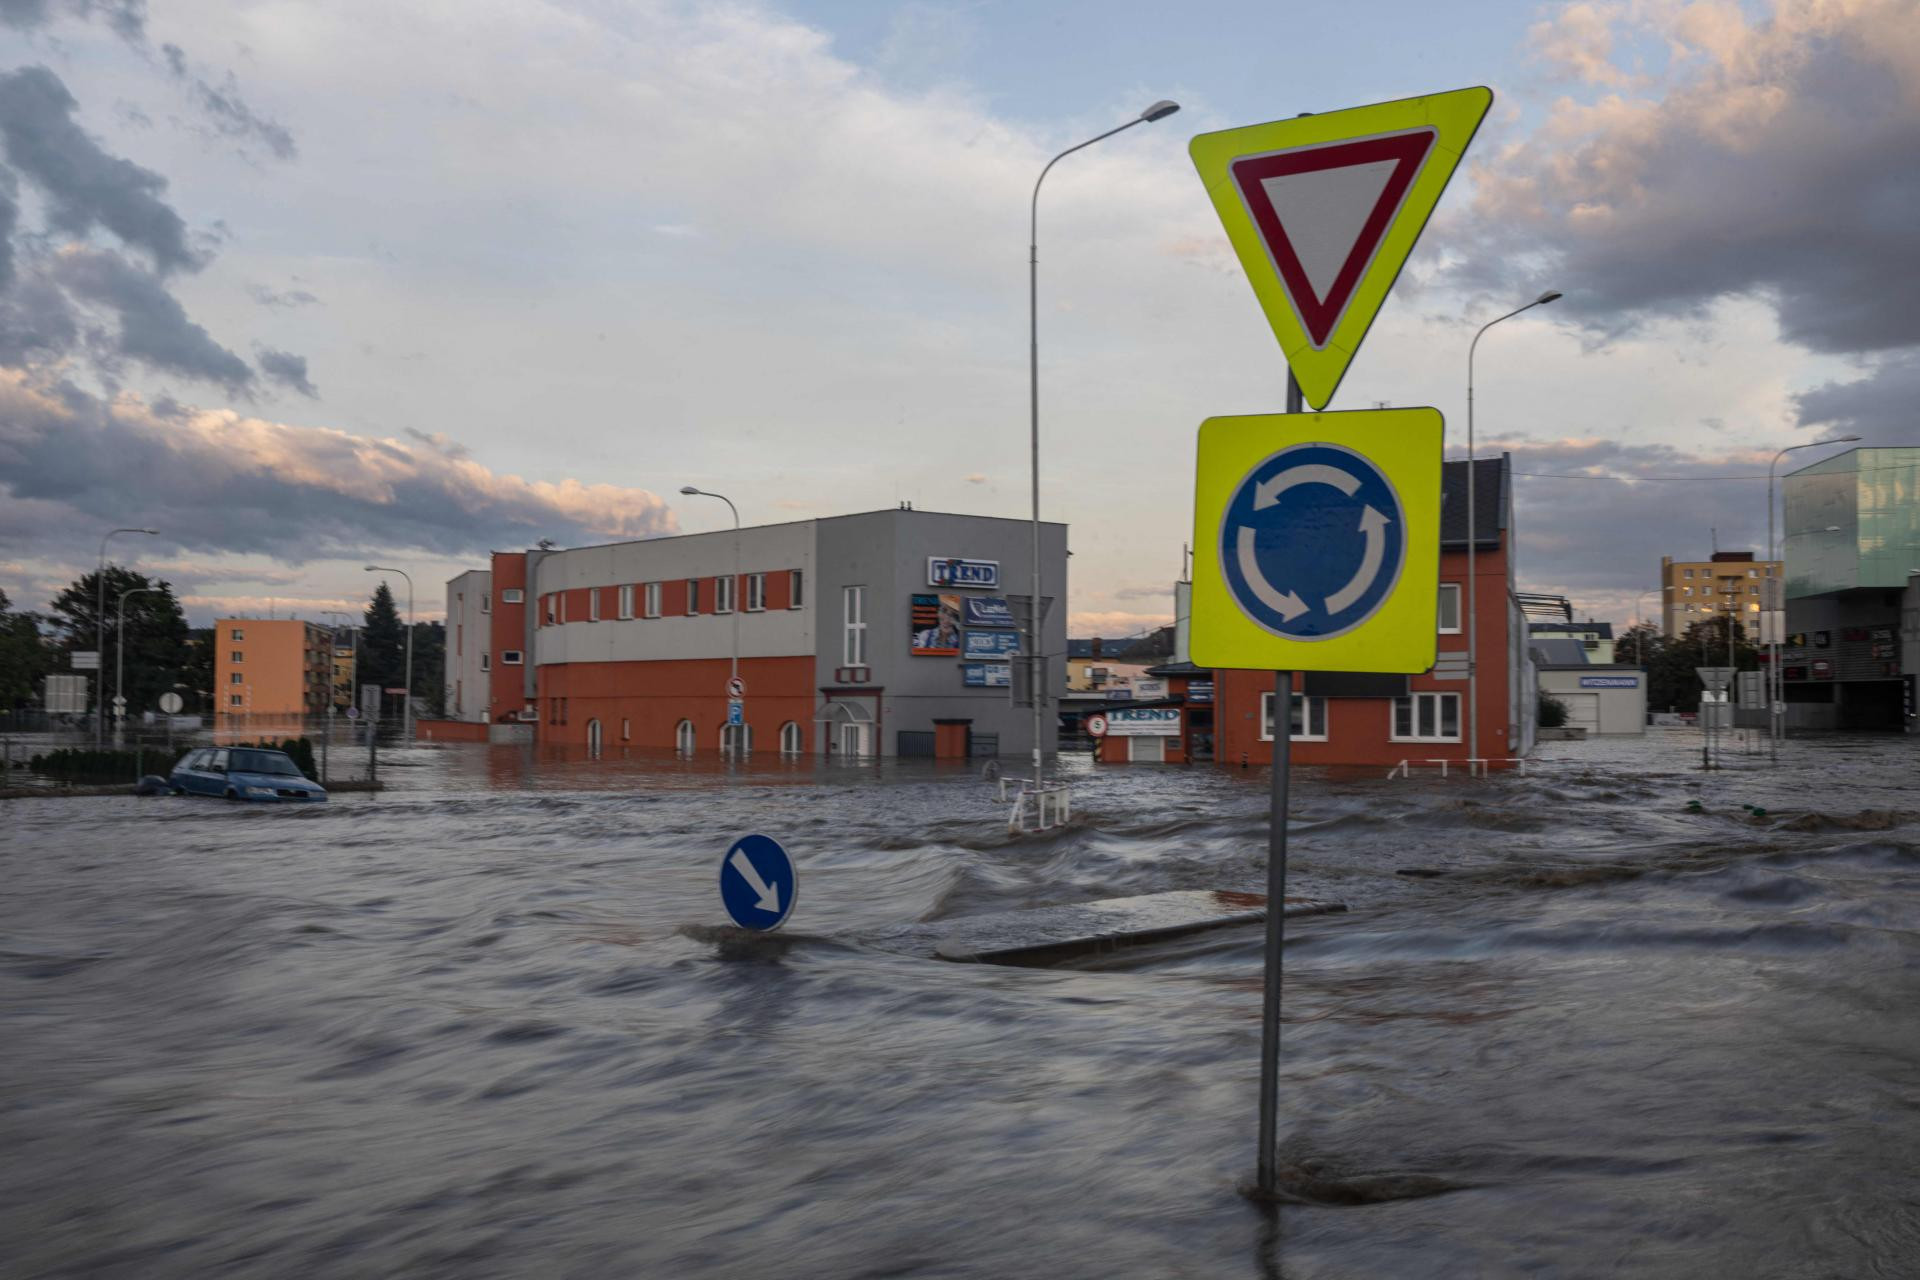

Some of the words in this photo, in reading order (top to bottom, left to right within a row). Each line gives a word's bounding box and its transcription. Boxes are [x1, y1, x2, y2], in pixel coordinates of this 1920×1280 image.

[937, 564, 993, 582] TREND
[1110, 709, 1180, 721] TREND
[1094, 720, 1102, 730] 5
